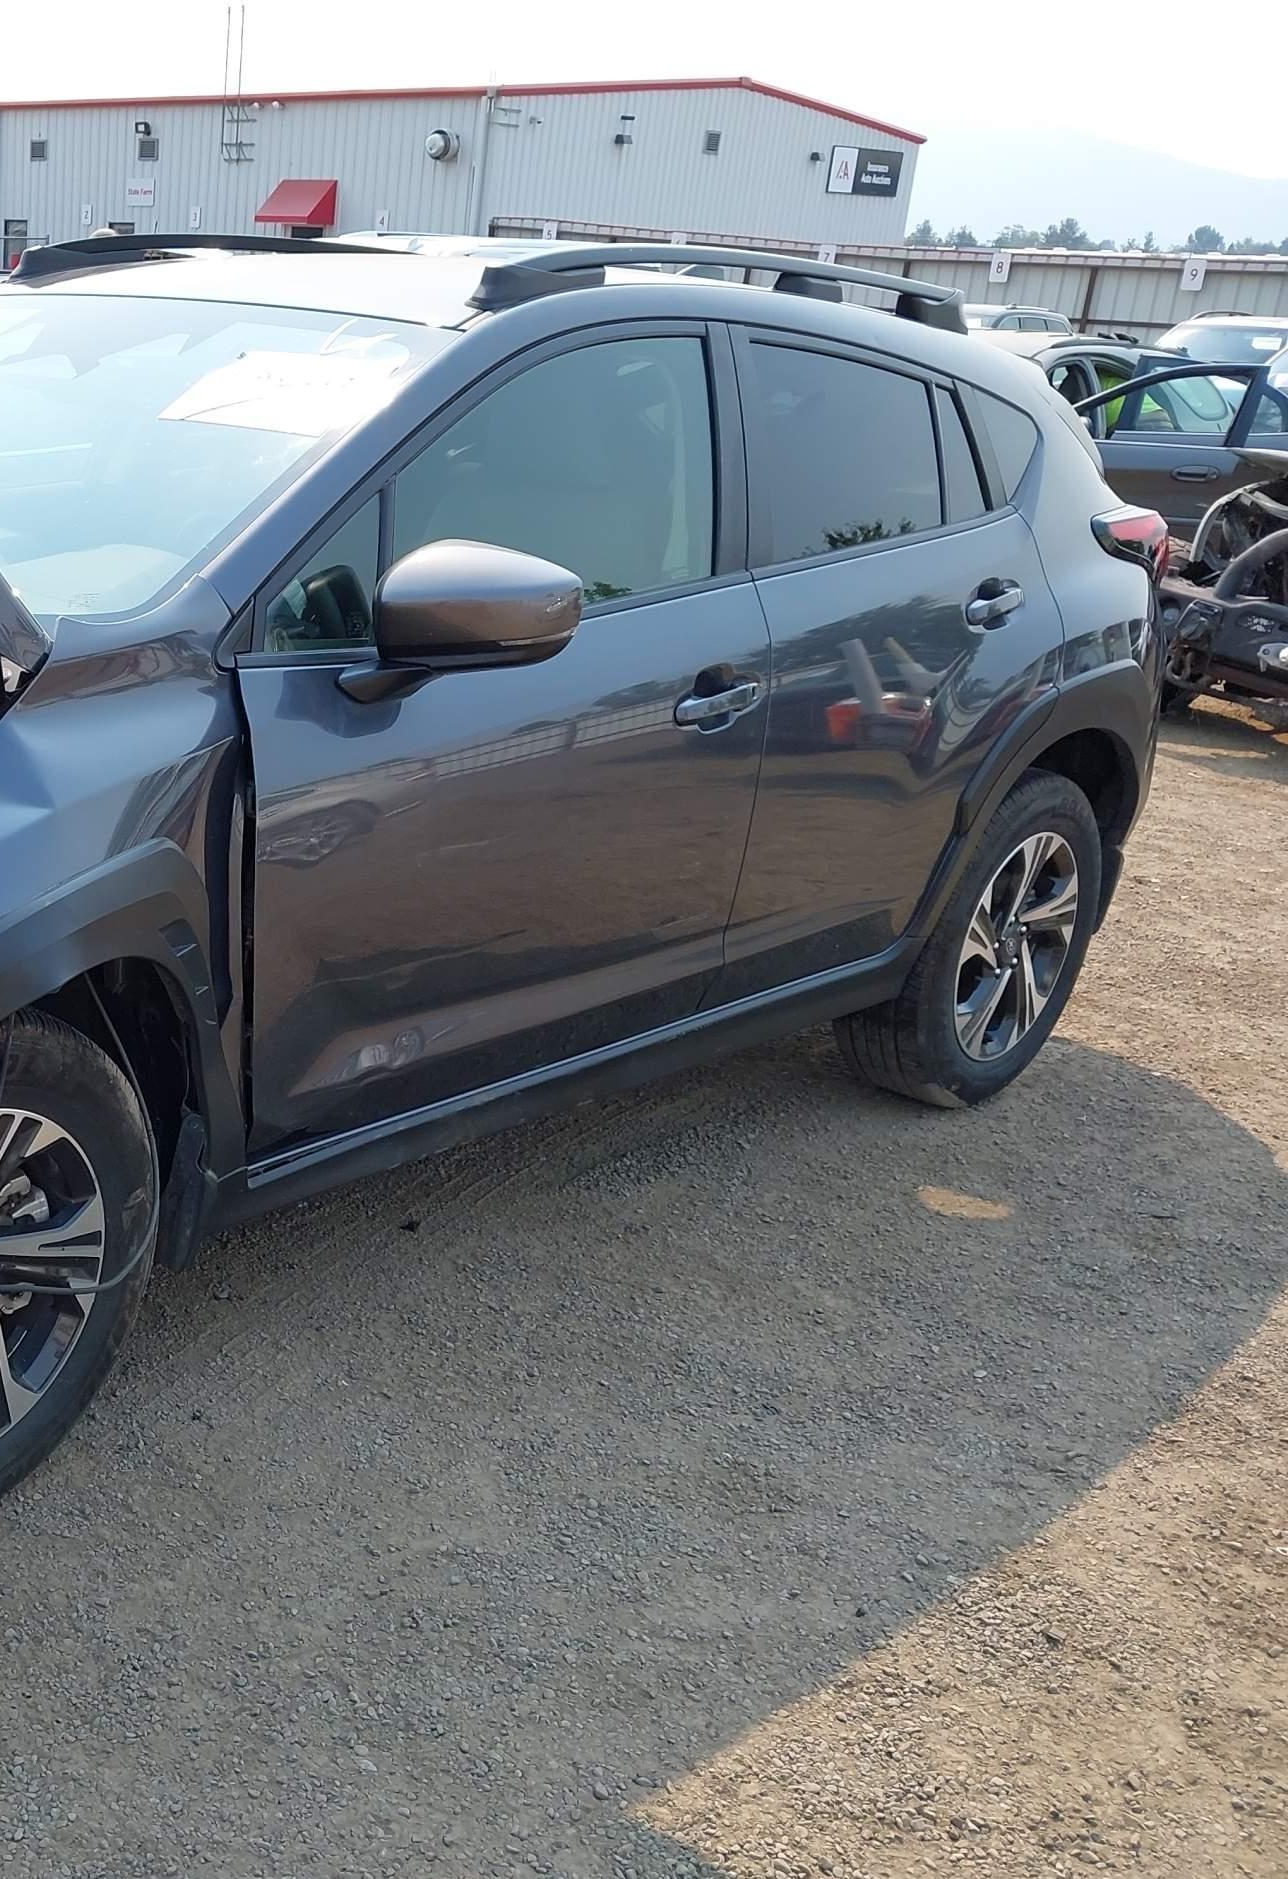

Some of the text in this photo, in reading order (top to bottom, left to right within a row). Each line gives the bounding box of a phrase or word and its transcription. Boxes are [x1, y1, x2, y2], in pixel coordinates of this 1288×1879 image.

[379, 215, 385, 226] 4
[823, 252, 831, 263] 7
[996, 261, 1004, 273] 8
[1190, 268, 1198, 281] 9
